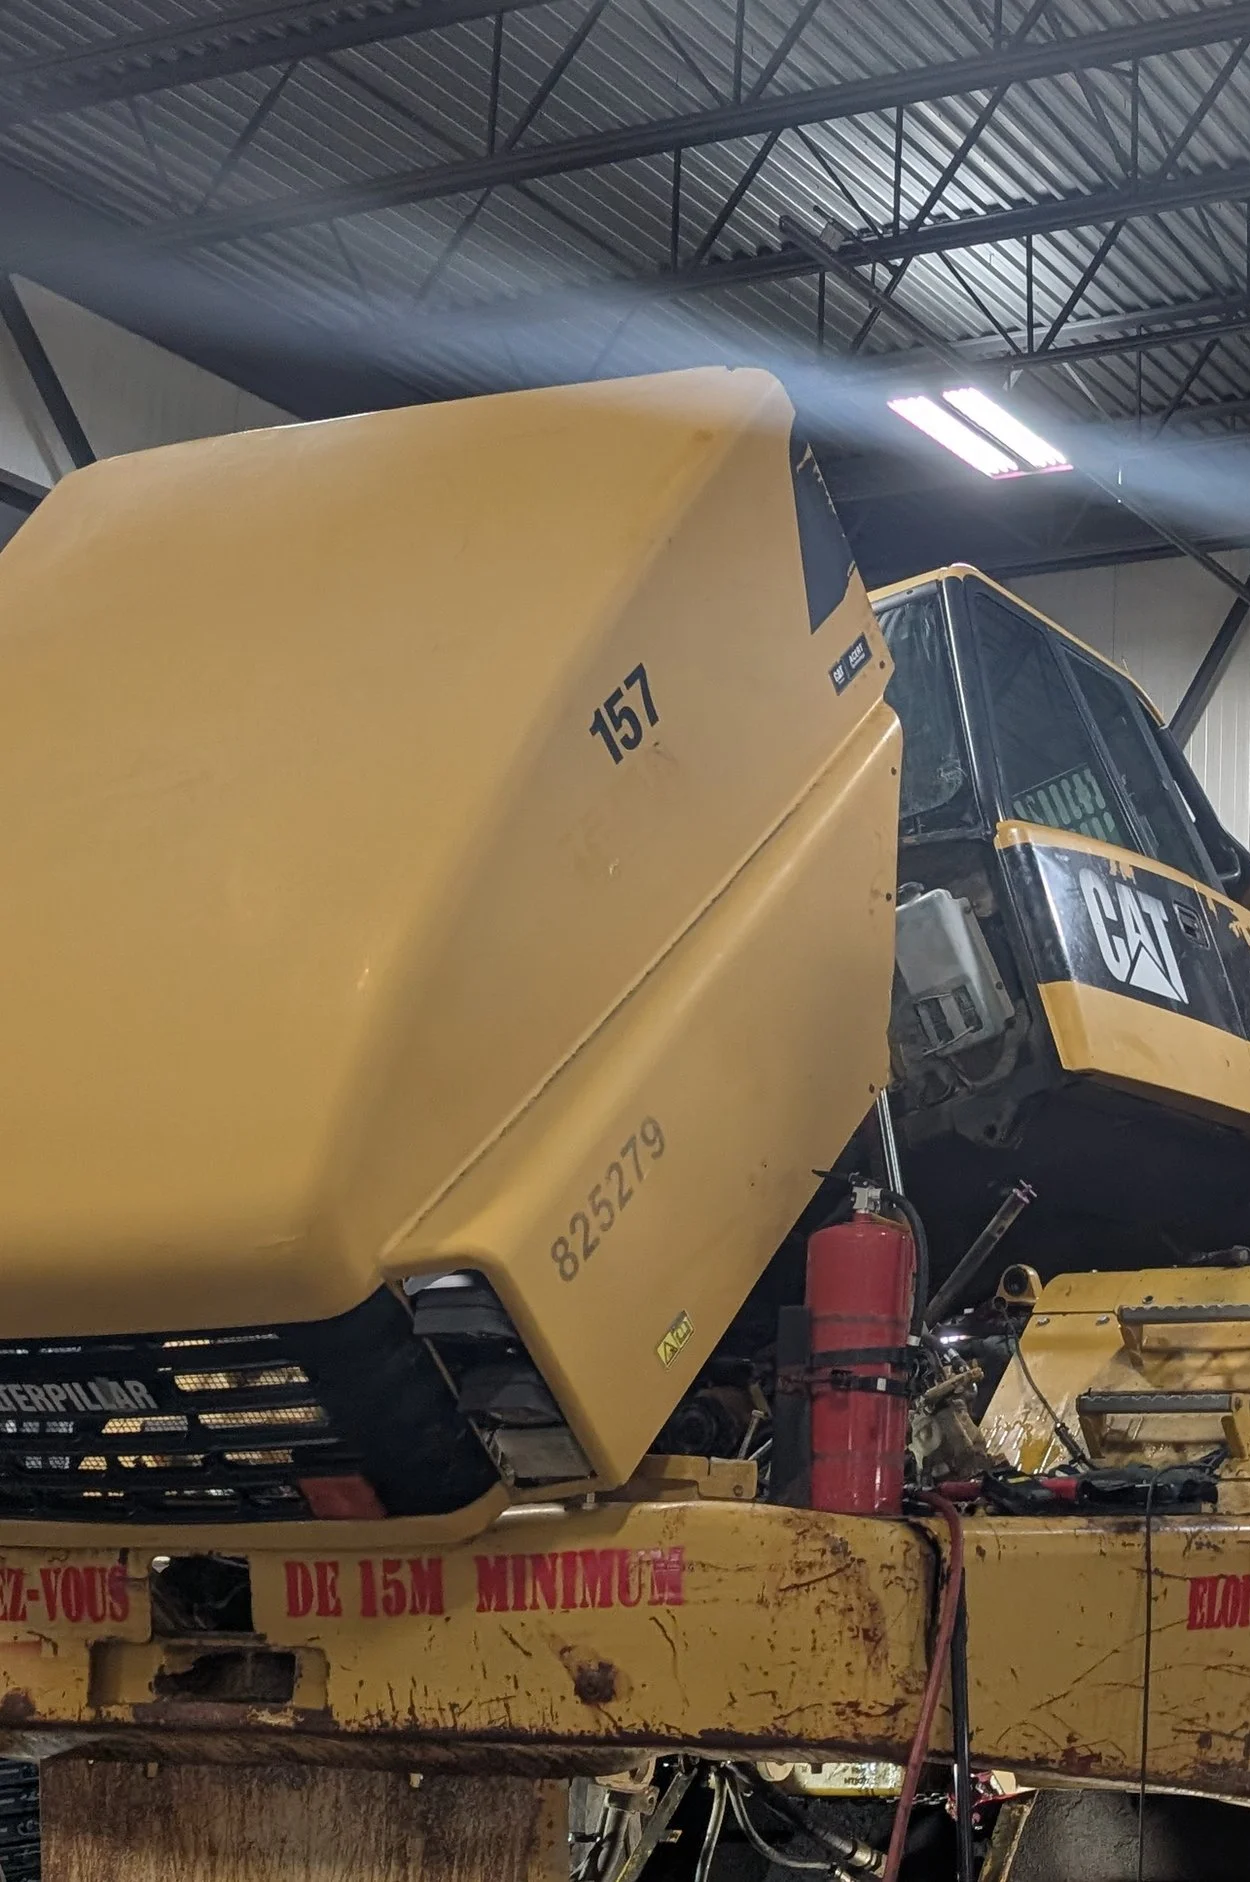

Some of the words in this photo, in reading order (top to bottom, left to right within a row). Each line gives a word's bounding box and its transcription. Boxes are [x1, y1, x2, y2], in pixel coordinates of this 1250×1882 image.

[589, 662, 659, 765] 157
[1079, 867, 1189, 1005] CAT
[551, 1115, 665, 1282] 825279
[284, 1560, 342, 1617] DE
[358, 1556, 444, 1617] 15M
[474, 1545, 686, 1613] MINIMUM
